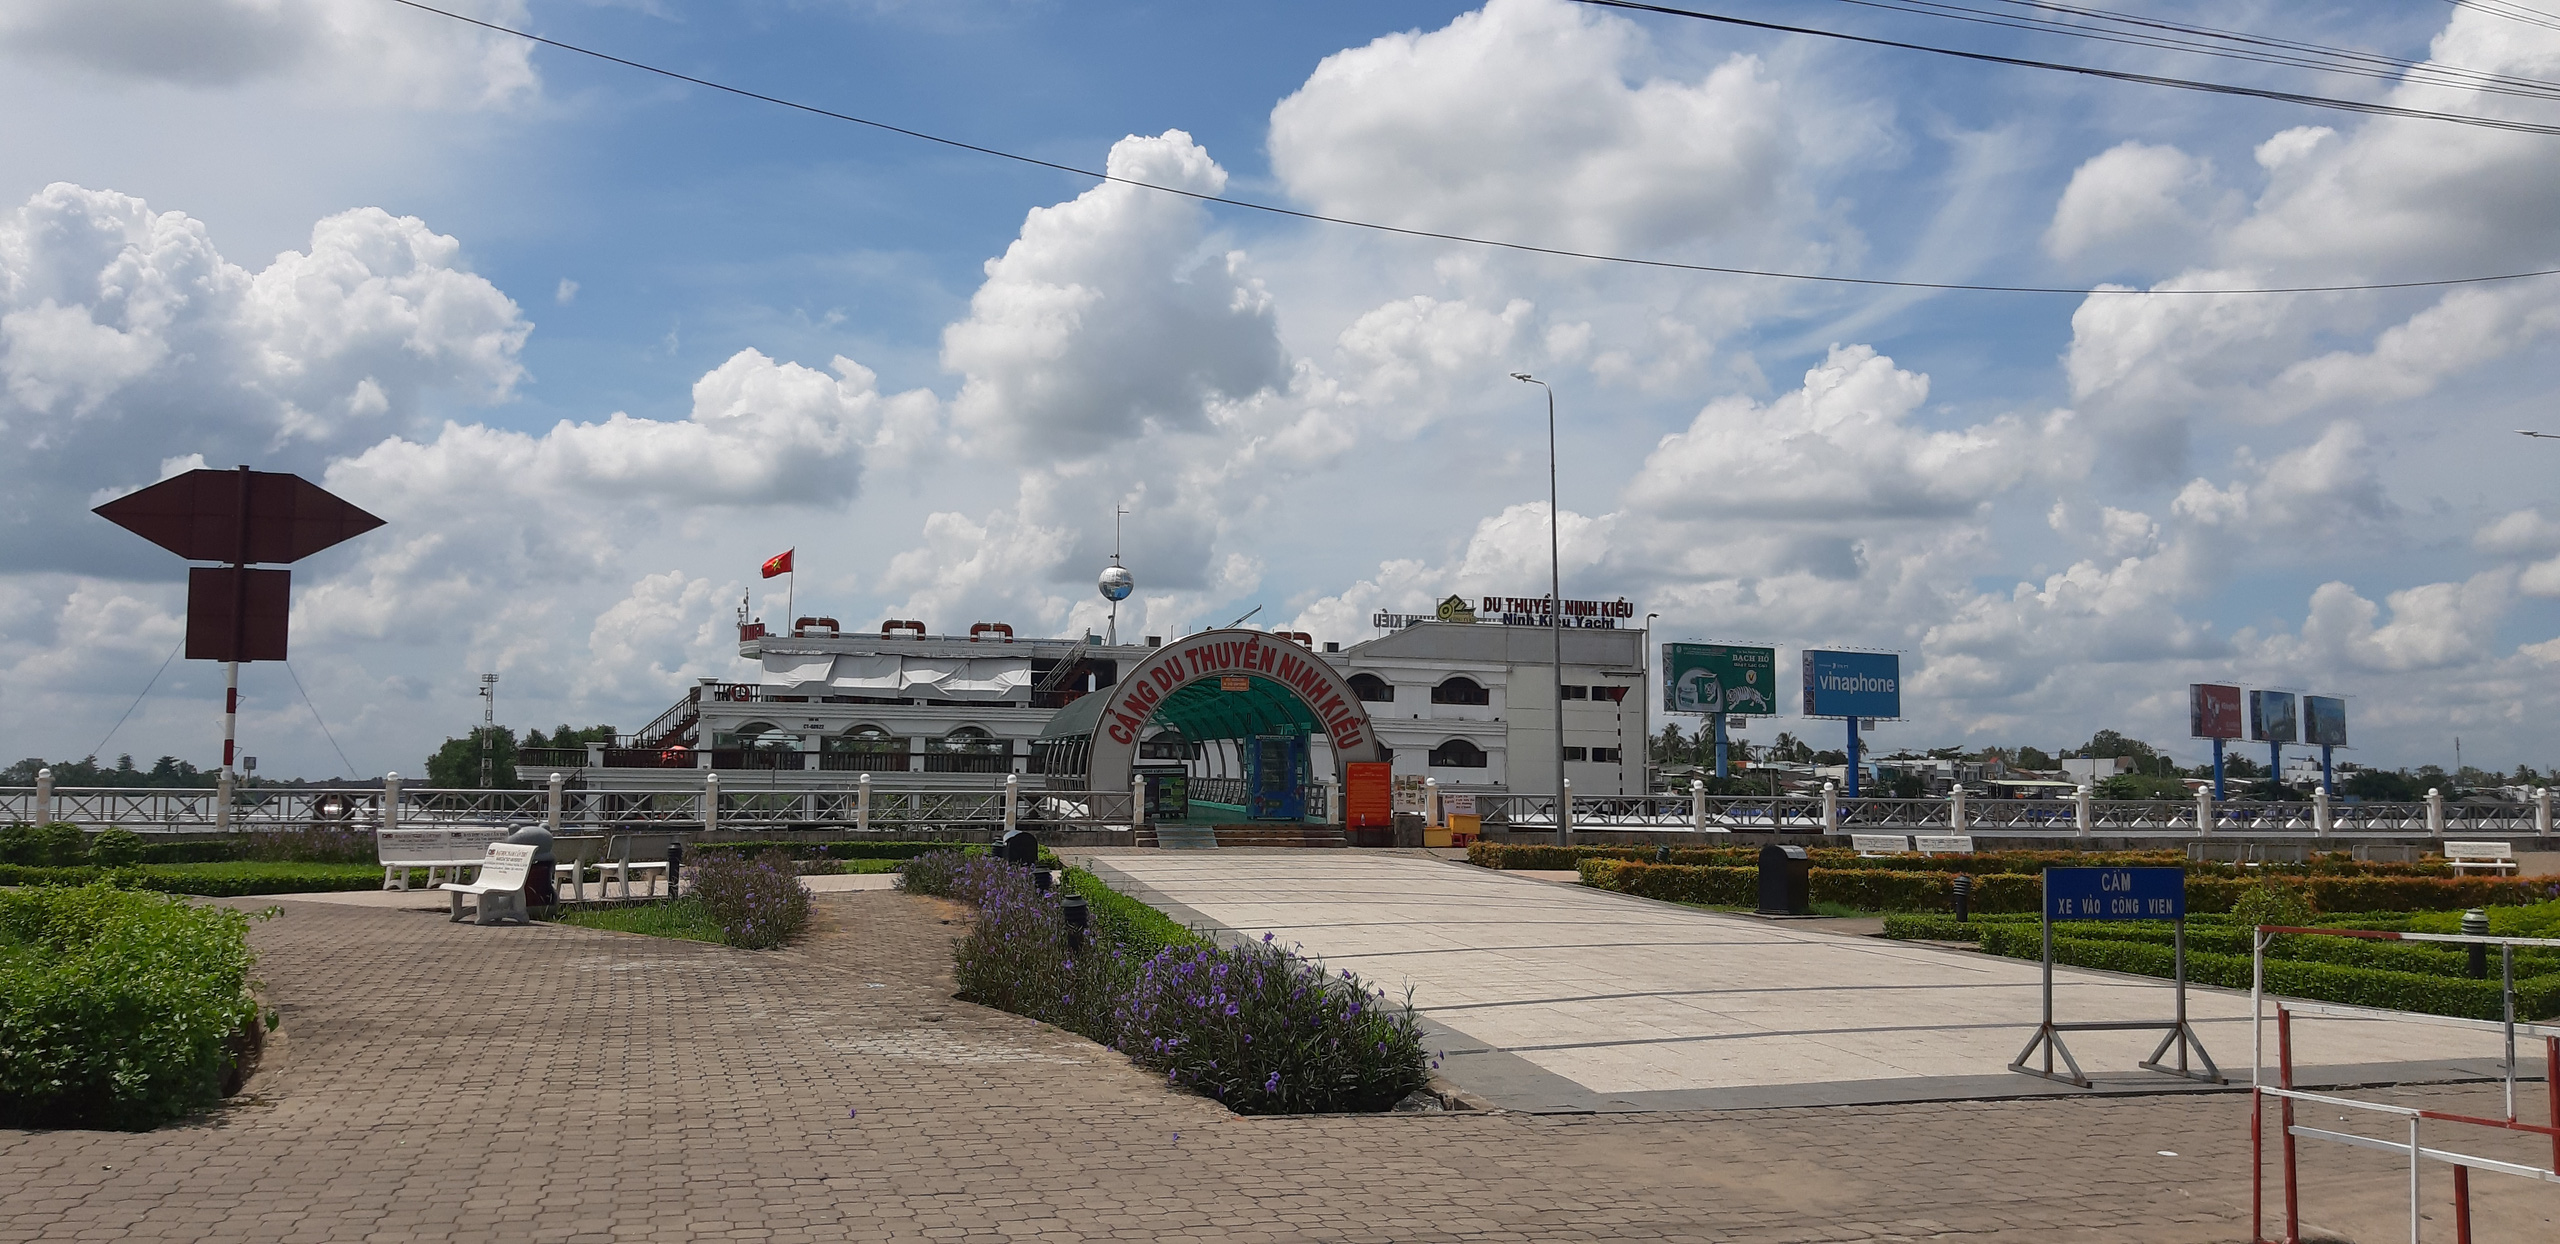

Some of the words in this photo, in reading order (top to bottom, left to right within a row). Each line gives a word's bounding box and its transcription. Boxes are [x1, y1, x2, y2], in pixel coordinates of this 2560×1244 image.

[1483, 596, 1502, 612] DU
[1565, 600, 1598, 617] NINH
[1601, 595, 1634, 618] KIỀU
[1503, 612, 1535, 626] Ninh
[1575, 615, 1615, 629] Yacht
[1732, 654, 1756, 663] BẠCH
[1108, 679, 1159, 745] CẢNG
[1150, 655, 1186, 692] DU
[1185, 634, 1278, 674] THUYỀN
[1277, 652, 1327, 704] NINH
[1319, 693, 1367, 750] KIỀU
[1819, 670, 1896, 694] vinaphone
[2101, 869, 2131, 891] CẤM
[2058, 898, 2072, 914] XE
[2082, 894, 2101, 914] VÀO
[2111, 896, 2140, 914] CÔNG
